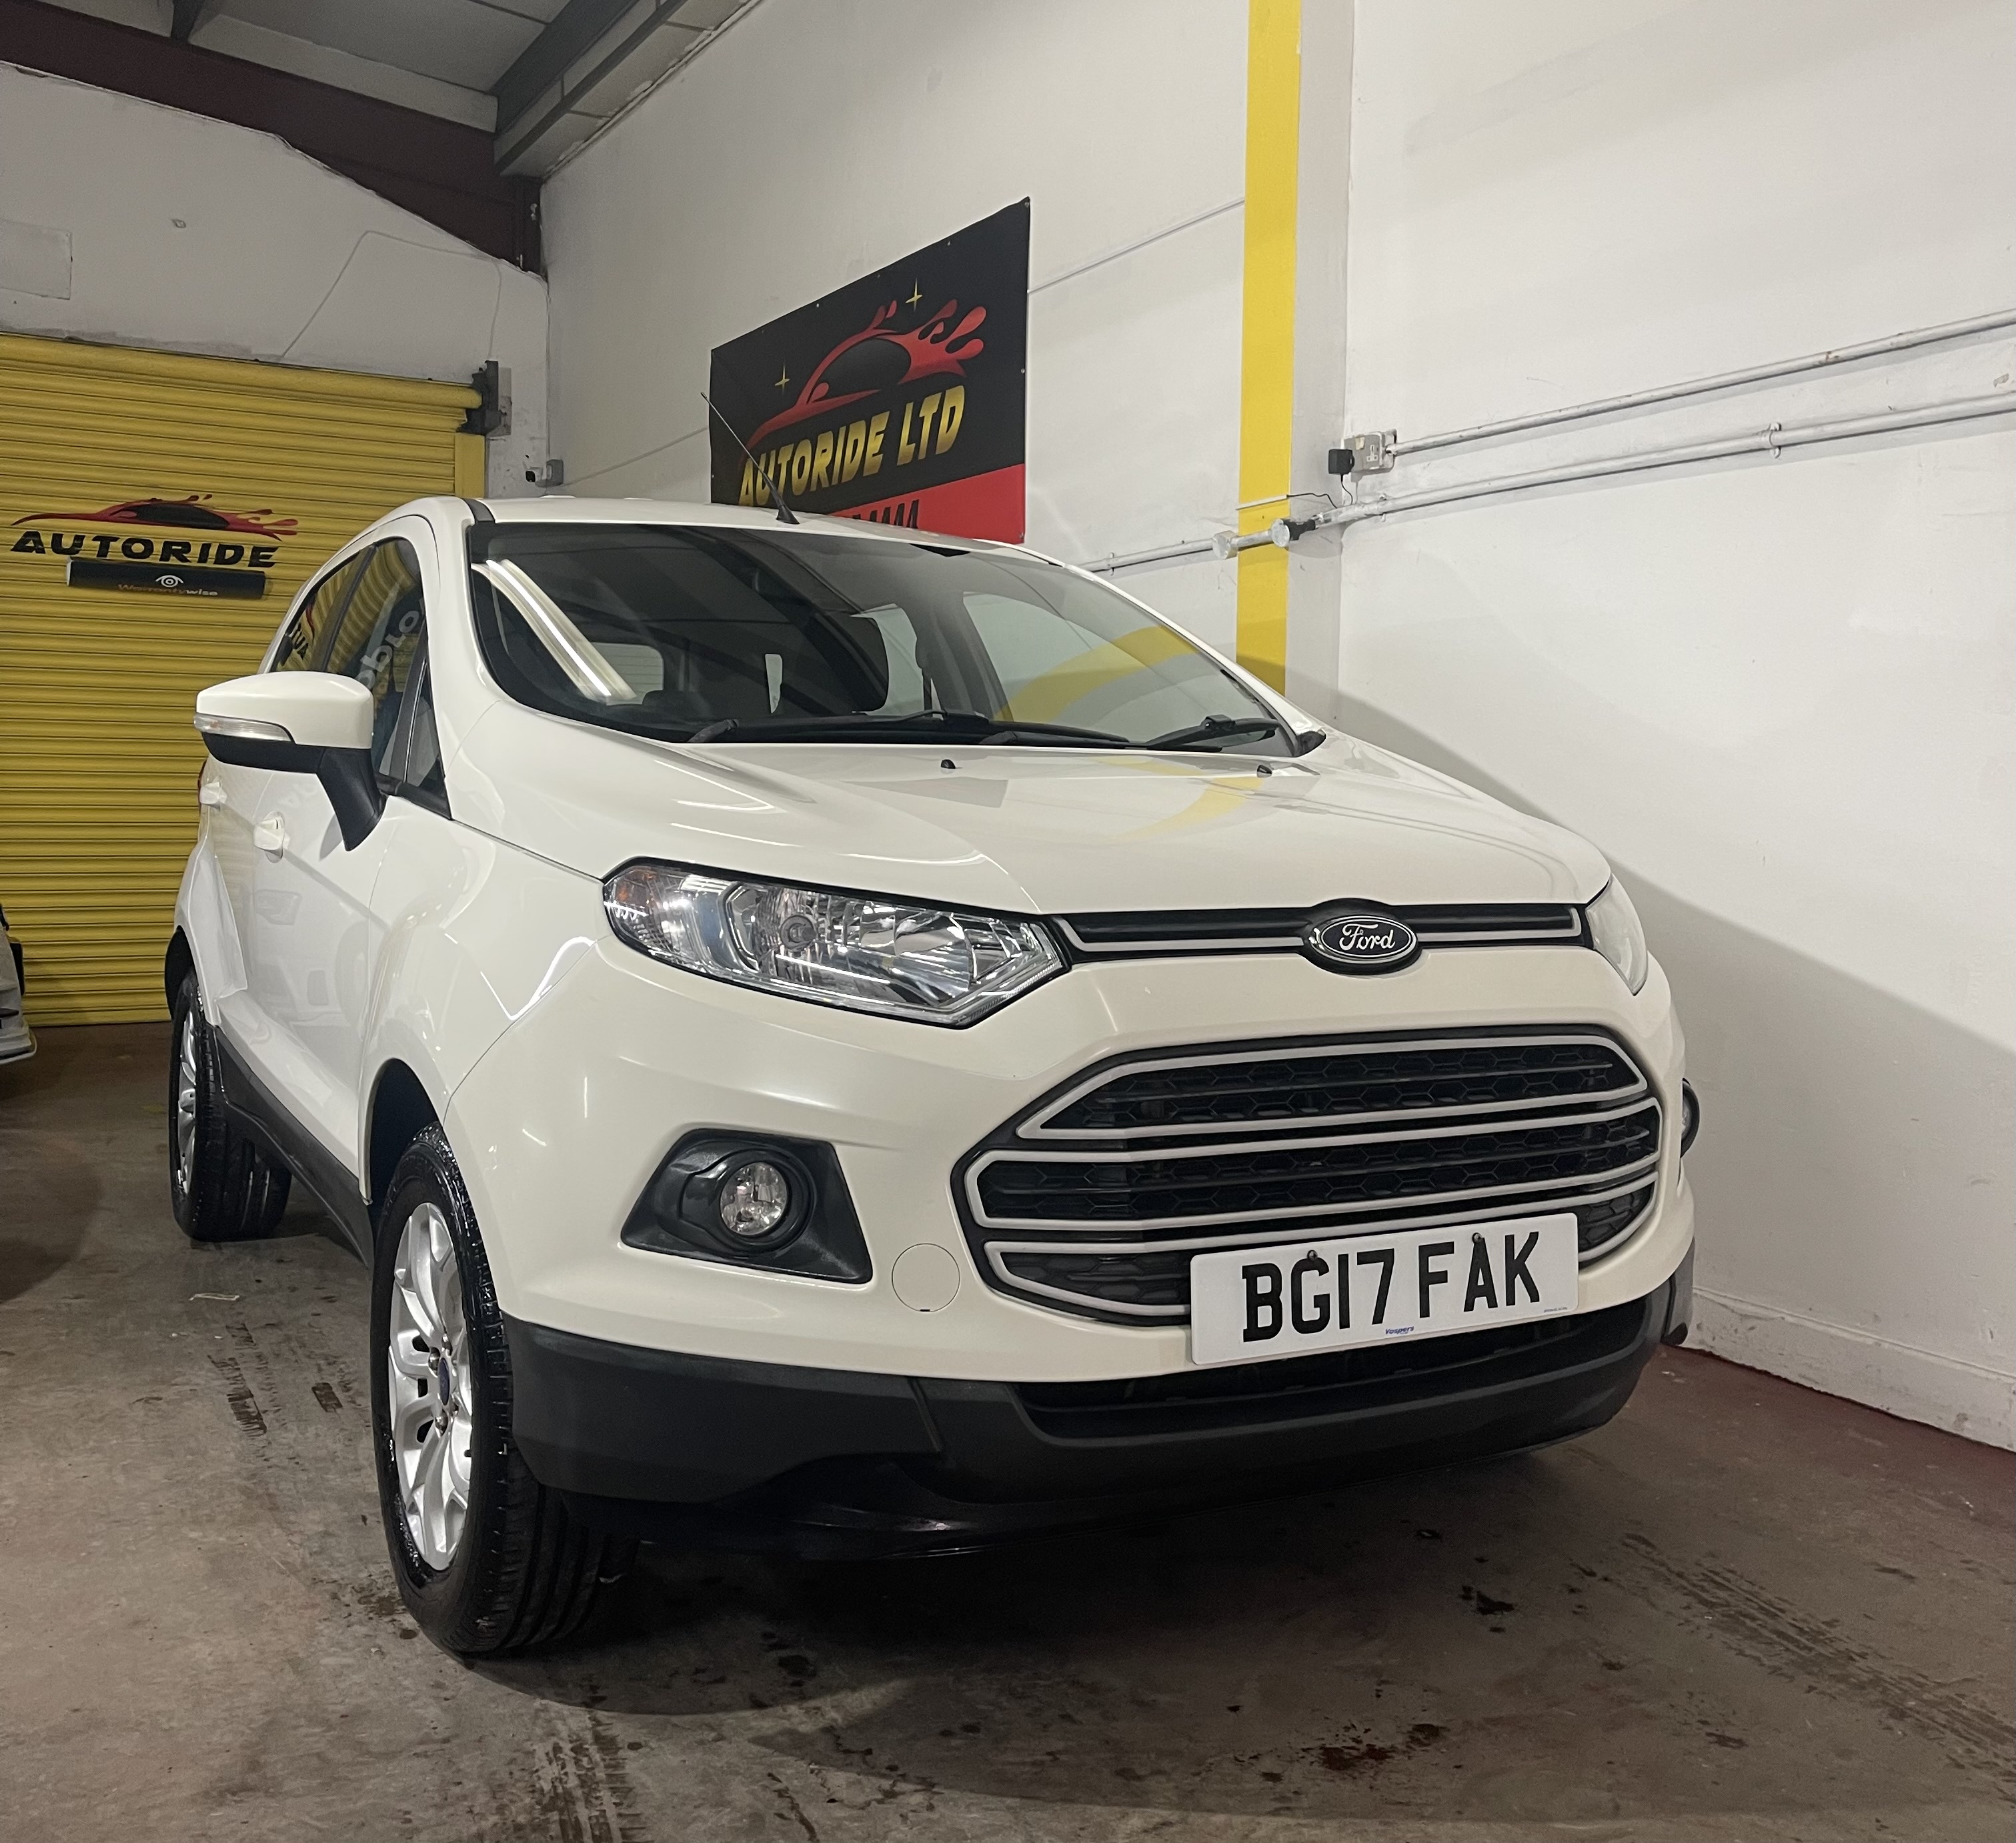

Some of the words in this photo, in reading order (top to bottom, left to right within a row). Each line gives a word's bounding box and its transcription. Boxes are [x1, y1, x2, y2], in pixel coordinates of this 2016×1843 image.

[739, 411, 890, 507] AUTORIDE
[897, 385, 965, 465] LTD
[11, 531, 279, 567] AUTORIDE
[1339, 924, 1396, 951] Ford
[1242, 1248, 1395, 1343] BG17
[1418, 1232, 1540, 1319] FAK
